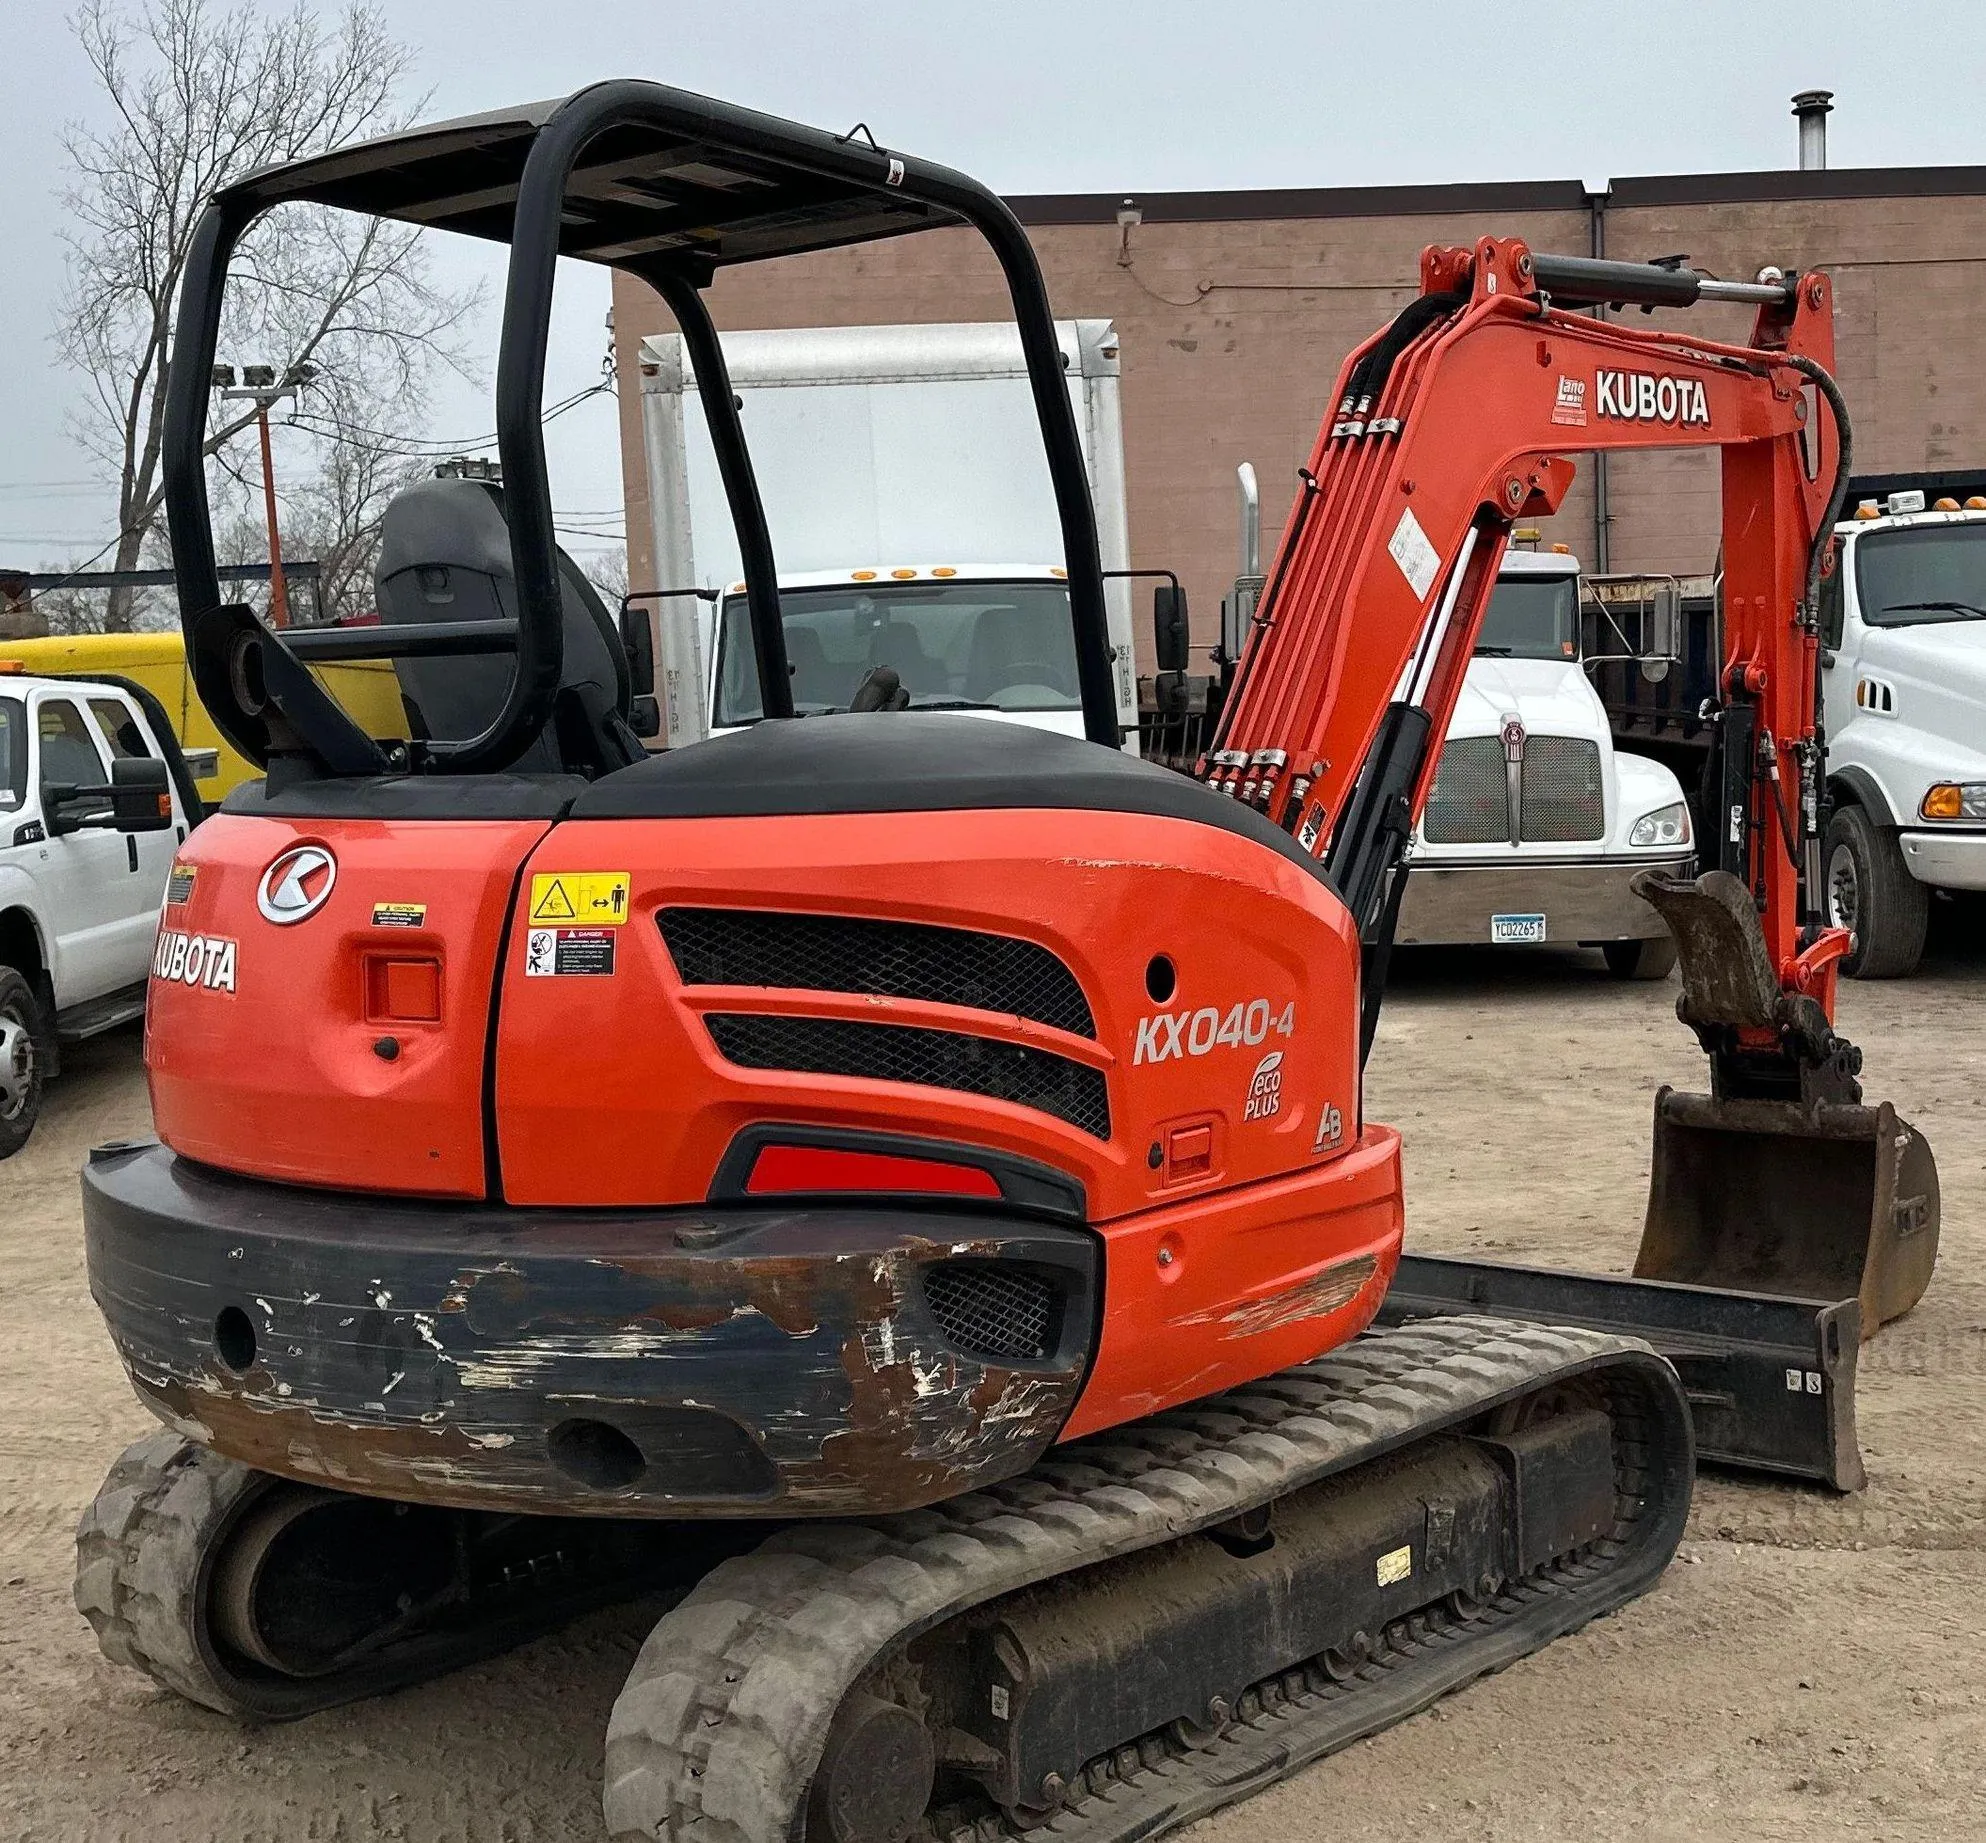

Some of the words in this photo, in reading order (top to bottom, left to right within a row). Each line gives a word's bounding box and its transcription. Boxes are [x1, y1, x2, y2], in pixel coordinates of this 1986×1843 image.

[1596, 370, 1709, 424] KUBOTA
[152, 931, 236, 993] KUBOTA
[1133, 999, 1295, 1066] KX040-4
[1244, 1093, 1280, 1122] PLUS
